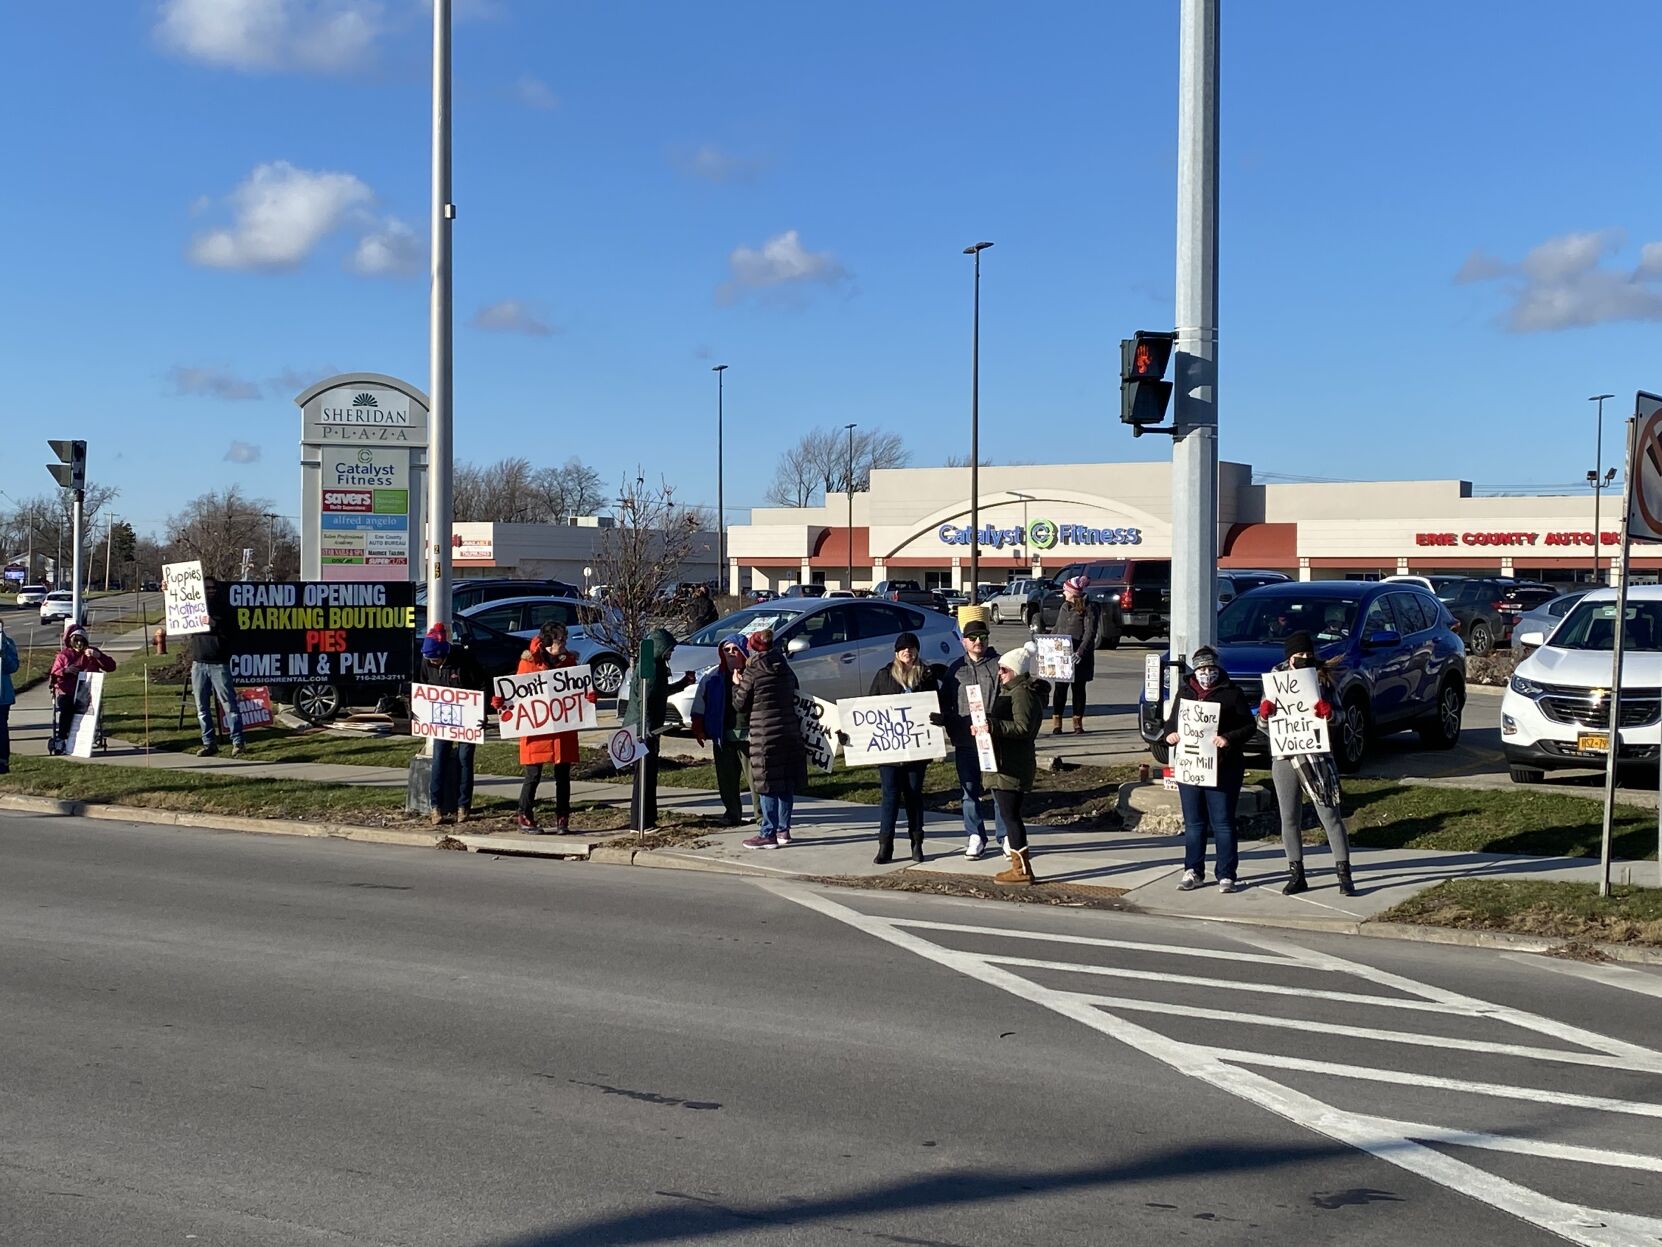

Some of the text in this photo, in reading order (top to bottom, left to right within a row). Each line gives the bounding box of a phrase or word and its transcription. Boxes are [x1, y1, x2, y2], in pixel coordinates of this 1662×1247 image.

[323, 408, 407, 424] SHERIDAN
[335, 462, 395, 478] Catalyst
[336, 474, 393, 487] Fitness
[332, 515, 397, 527] alfred angelo
[1059, 524, 1138, 543] Fitness
[1416, 532, 1458, 546] ERIE
[1462, 532, 1538, 546] COUNTY
[1544, 532, 1595, 546] AUTO
[165, 567, 202, 587] Puppies
[170, 585, 202, 602] 4 Sale
[229, 584, 386, 607] GRAND OPENING
[168, 602, 206, 616] Mothers
[237, 607, 416, 630] BARKING BOUTIQUE
[168, 618, 180, 629] in
[306, 630, 347, 653] PIES
[229, 652, 388, 676] COME IN & PLAY
[497, 671, 592, 701] Don't Shop
[1272, 673, 1301, 694] We
[413, 685, 482, 706] ADOPT
[516, 692, 585, 730] ADOPT
[852, 705, 912, 726] DON'T
[1194, 704, 1218, 723] Store
[1274, 697, 1310, 716] Are
[413, 722, 482, 741] DON'T SHOP
[1183, 723, 1205, 744] Dogs
[1271, 716, 1315, 735] Their
[866, 730, 932, 752] ADOPT!
[1274, 728, 1322, 752] Voice!
[1196, 757, 1214, 770] Mill
[1183, 771, 1206, 785] Dogs
